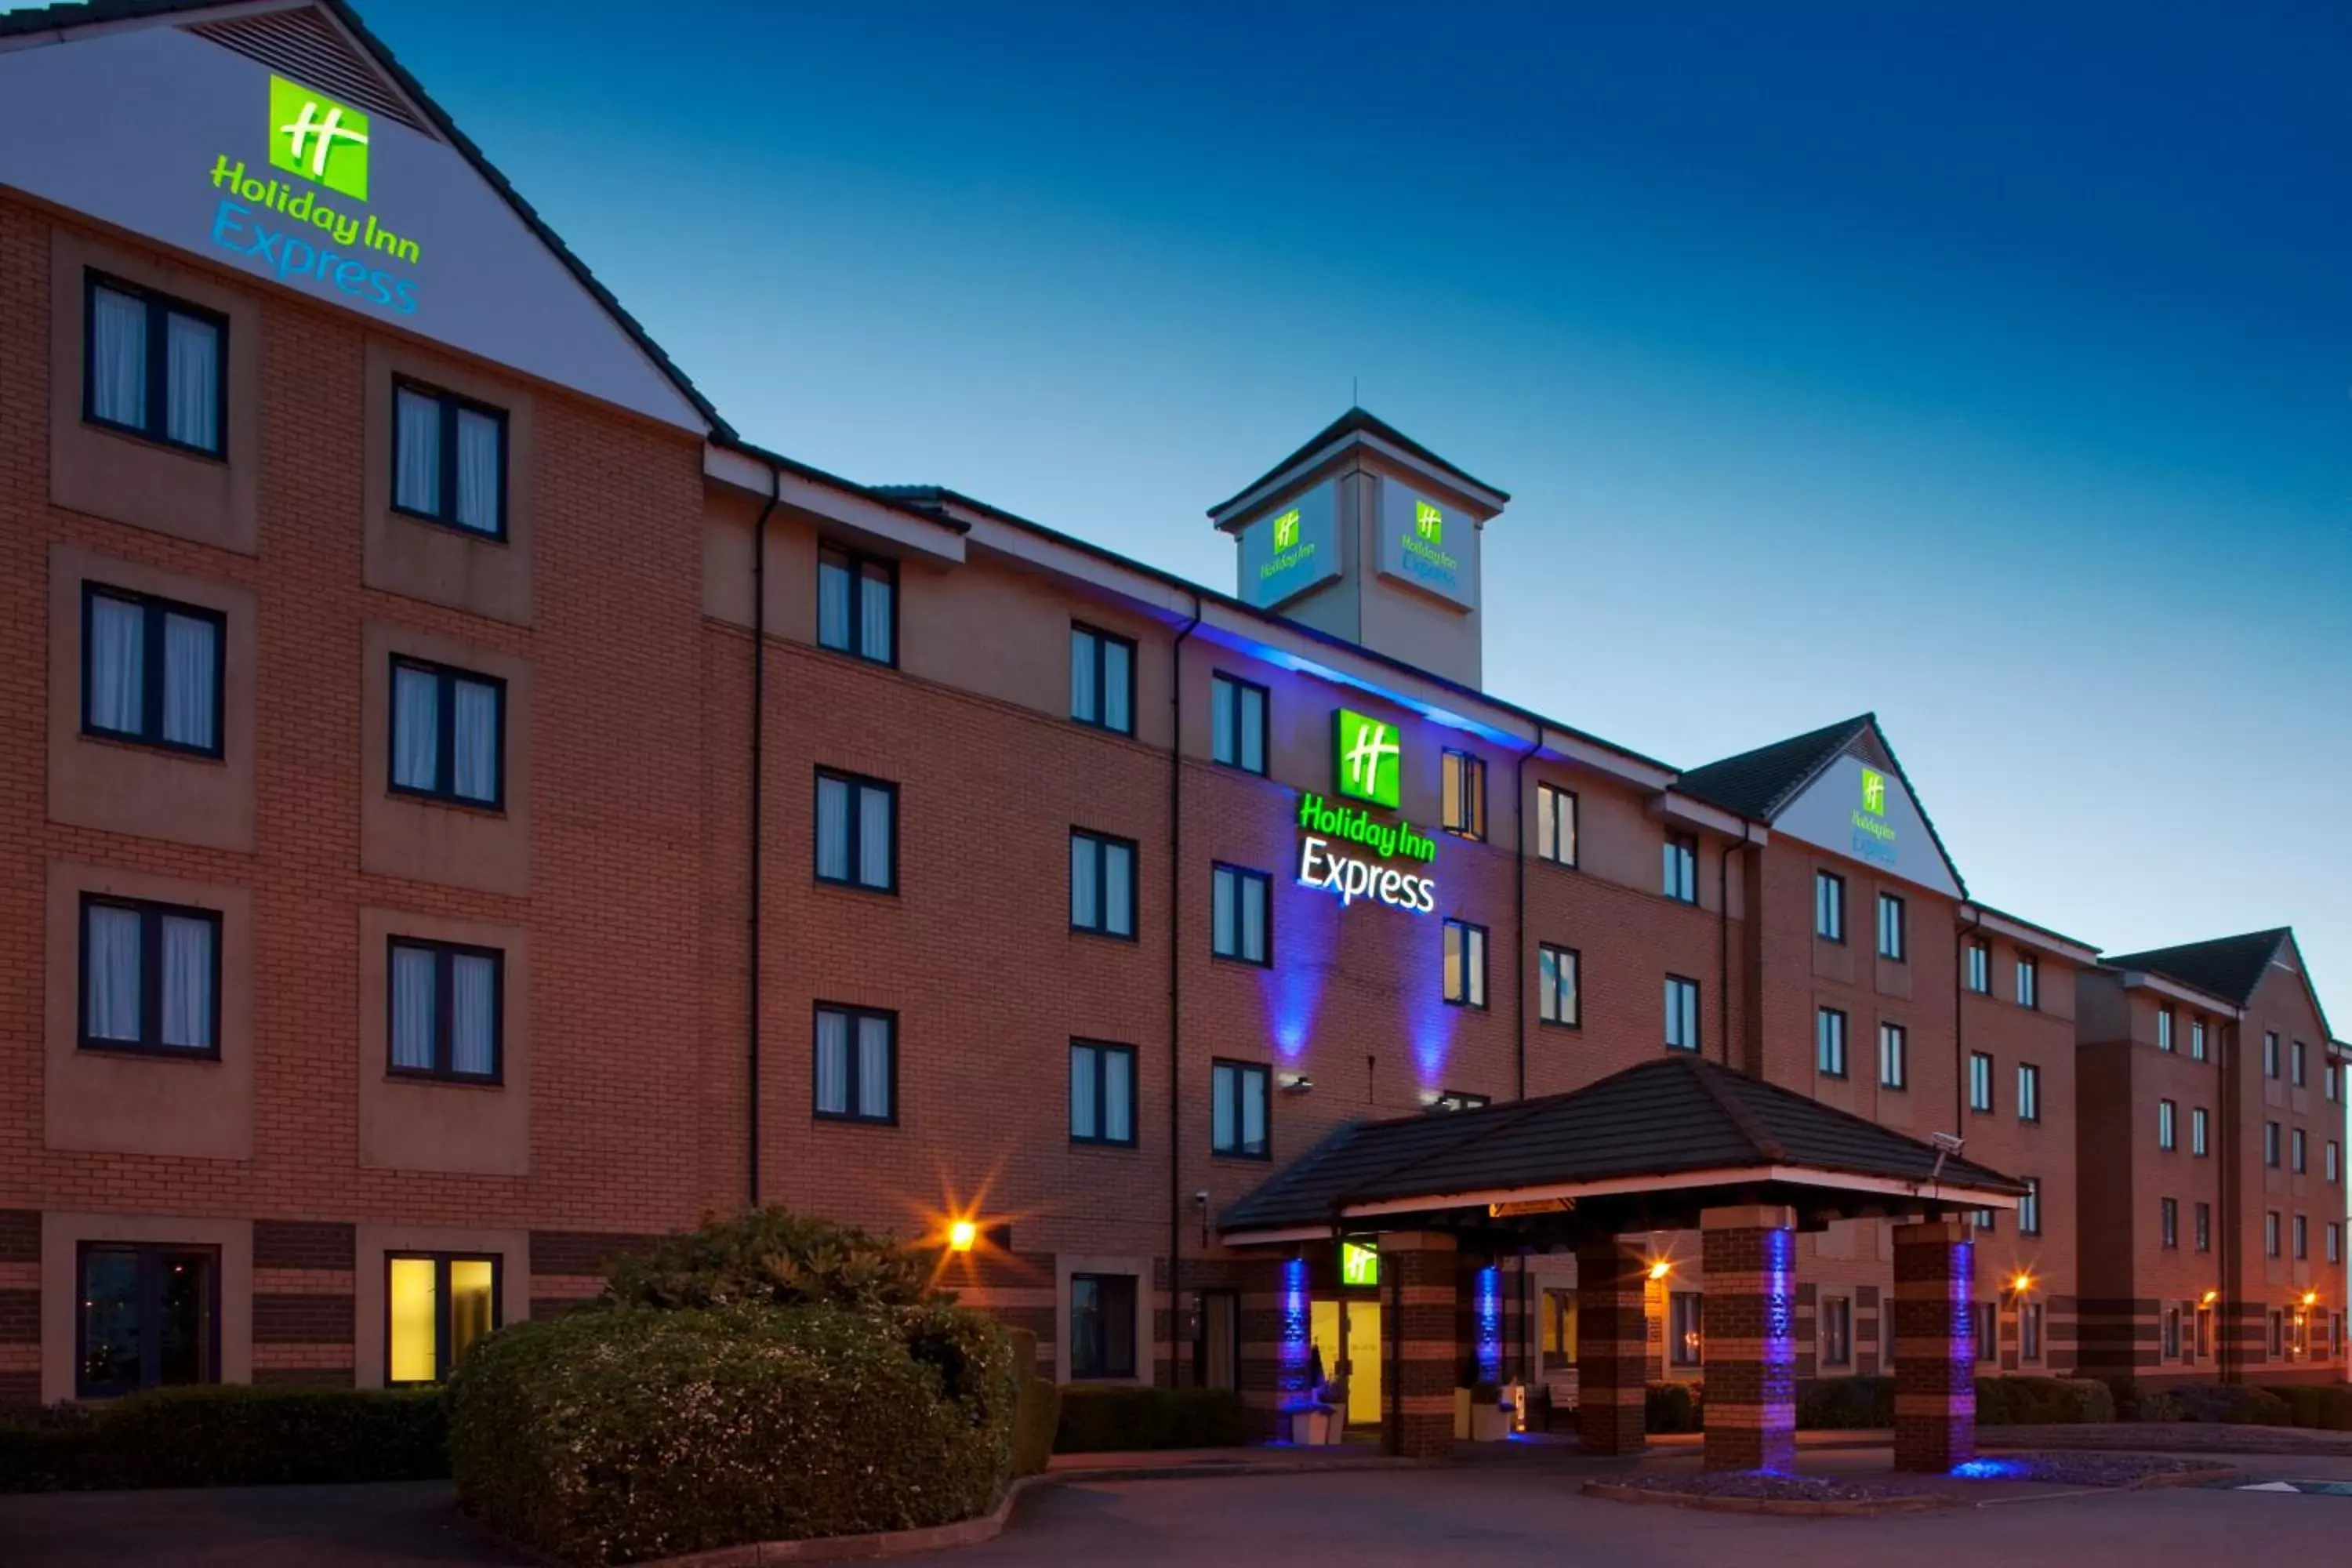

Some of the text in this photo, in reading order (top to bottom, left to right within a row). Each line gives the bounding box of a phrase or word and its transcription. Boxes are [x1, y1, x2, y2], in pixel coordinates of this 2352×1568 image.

[210, 154, 420, 264] Holiday Inn
[211, 199, 419, 315] Express
[1301, 793, 1436, 862] Holiday Inn
[1301, 837, 1435, 913] Express
